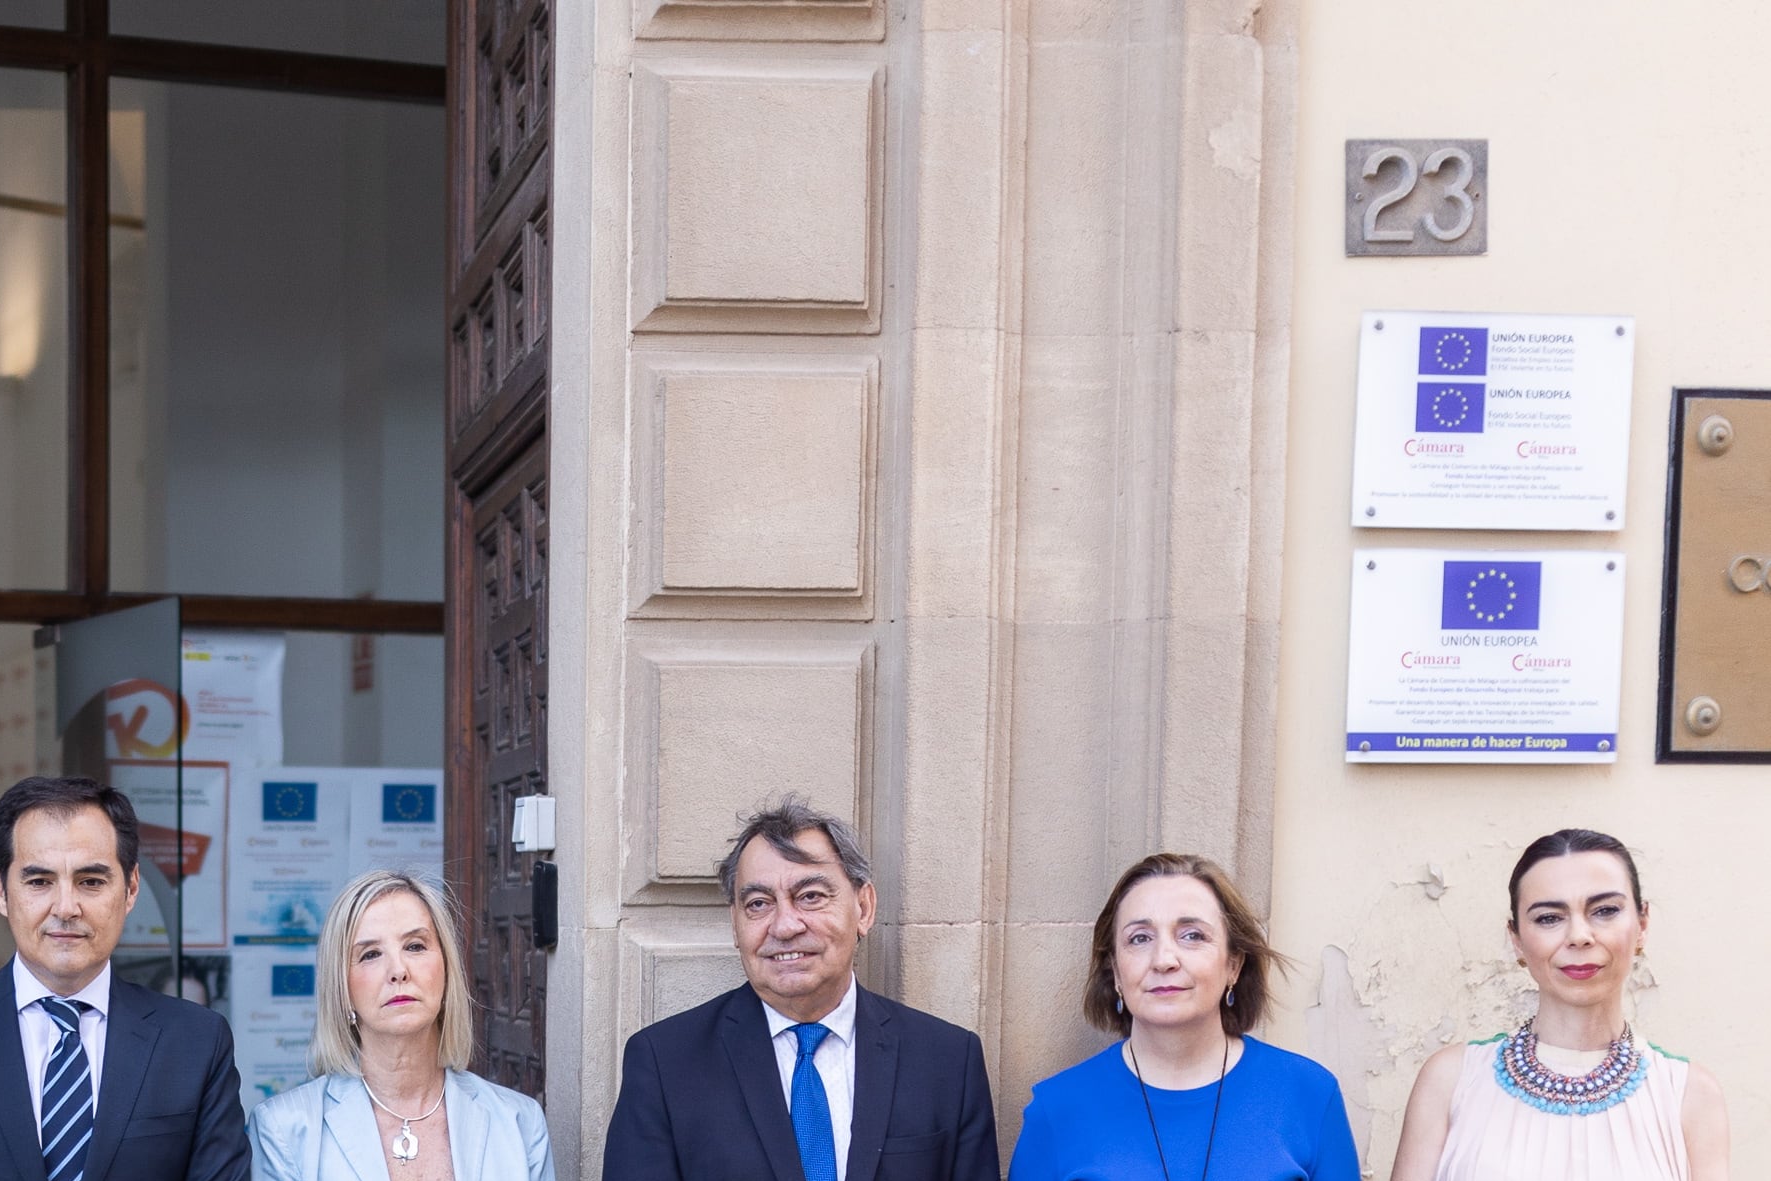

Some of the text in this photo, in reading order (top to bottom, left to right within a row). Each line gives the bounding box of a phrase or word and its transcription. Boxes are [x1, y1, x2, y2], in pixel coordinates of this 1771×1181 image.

[1362, 148, 1474, 241] 23
[1492, 332, 1574, 344] UNIÓN EUROPEA
[1492, 345, 1516, 354] Fondo
[1518, 345, 1541, 354] Social
[1489, 388, 1571, 400] UNIÓN EUROPEA
[1488, 411, 1513, 420] Fondo
[1515, 411, 1536, 420] Social
[1404, 439, 1464, 456] Cámara
[1517, 441, 1576, 458] Cámara
[1441, 633, 1538, 647] UNIÓN EUROPEA
[1401, 651, 1461, 668] Cámara
[1512, 653, 1571, 671] Cámara
[1396, 736, 1567, 751] Una manera de hacer Europa
